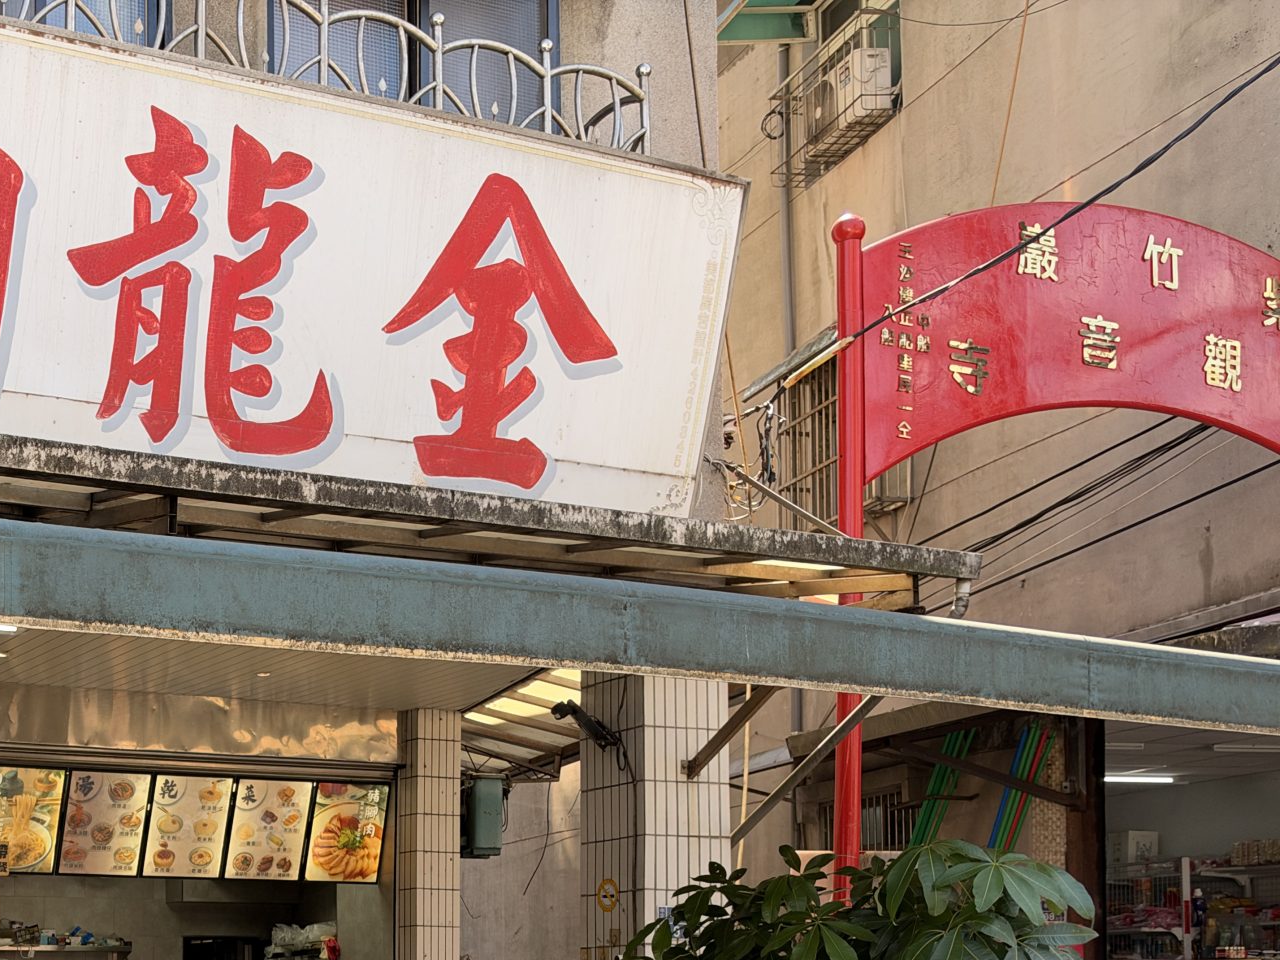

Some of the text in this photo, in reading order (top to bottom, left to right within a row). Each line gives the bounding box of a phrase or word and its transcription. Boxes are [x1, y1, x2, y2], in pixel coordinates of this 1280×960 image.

[949, 315, 1241, 395] 觀音寺
[159, 779, 179, 799] 乾
[241, 784, 257, 806] 菜
